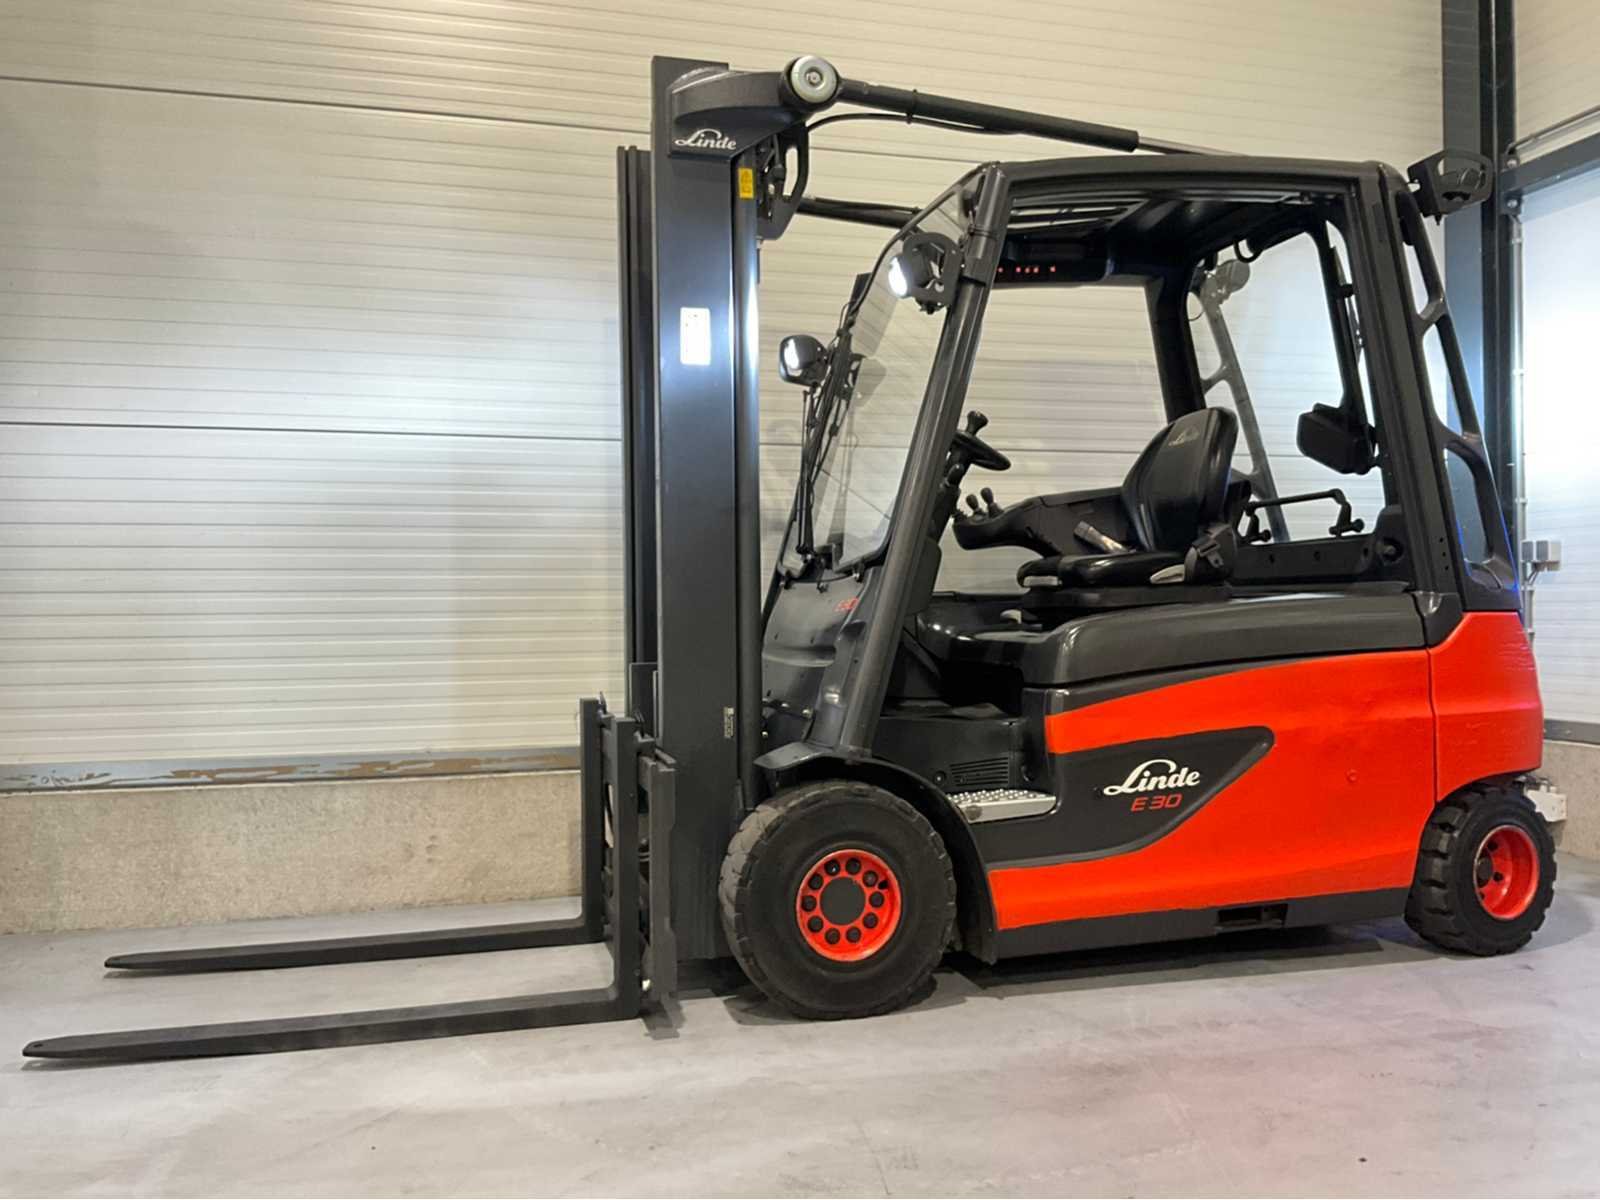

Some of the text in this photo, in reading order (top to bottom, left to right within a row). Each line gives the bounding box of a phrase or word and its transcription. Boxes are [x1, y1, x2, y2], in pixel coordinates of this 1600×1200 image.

[674, 128, 737, 150] Linde
[1103, 759, 1201, 796] Linde
[1130, 793, 1183, 813] E 30
